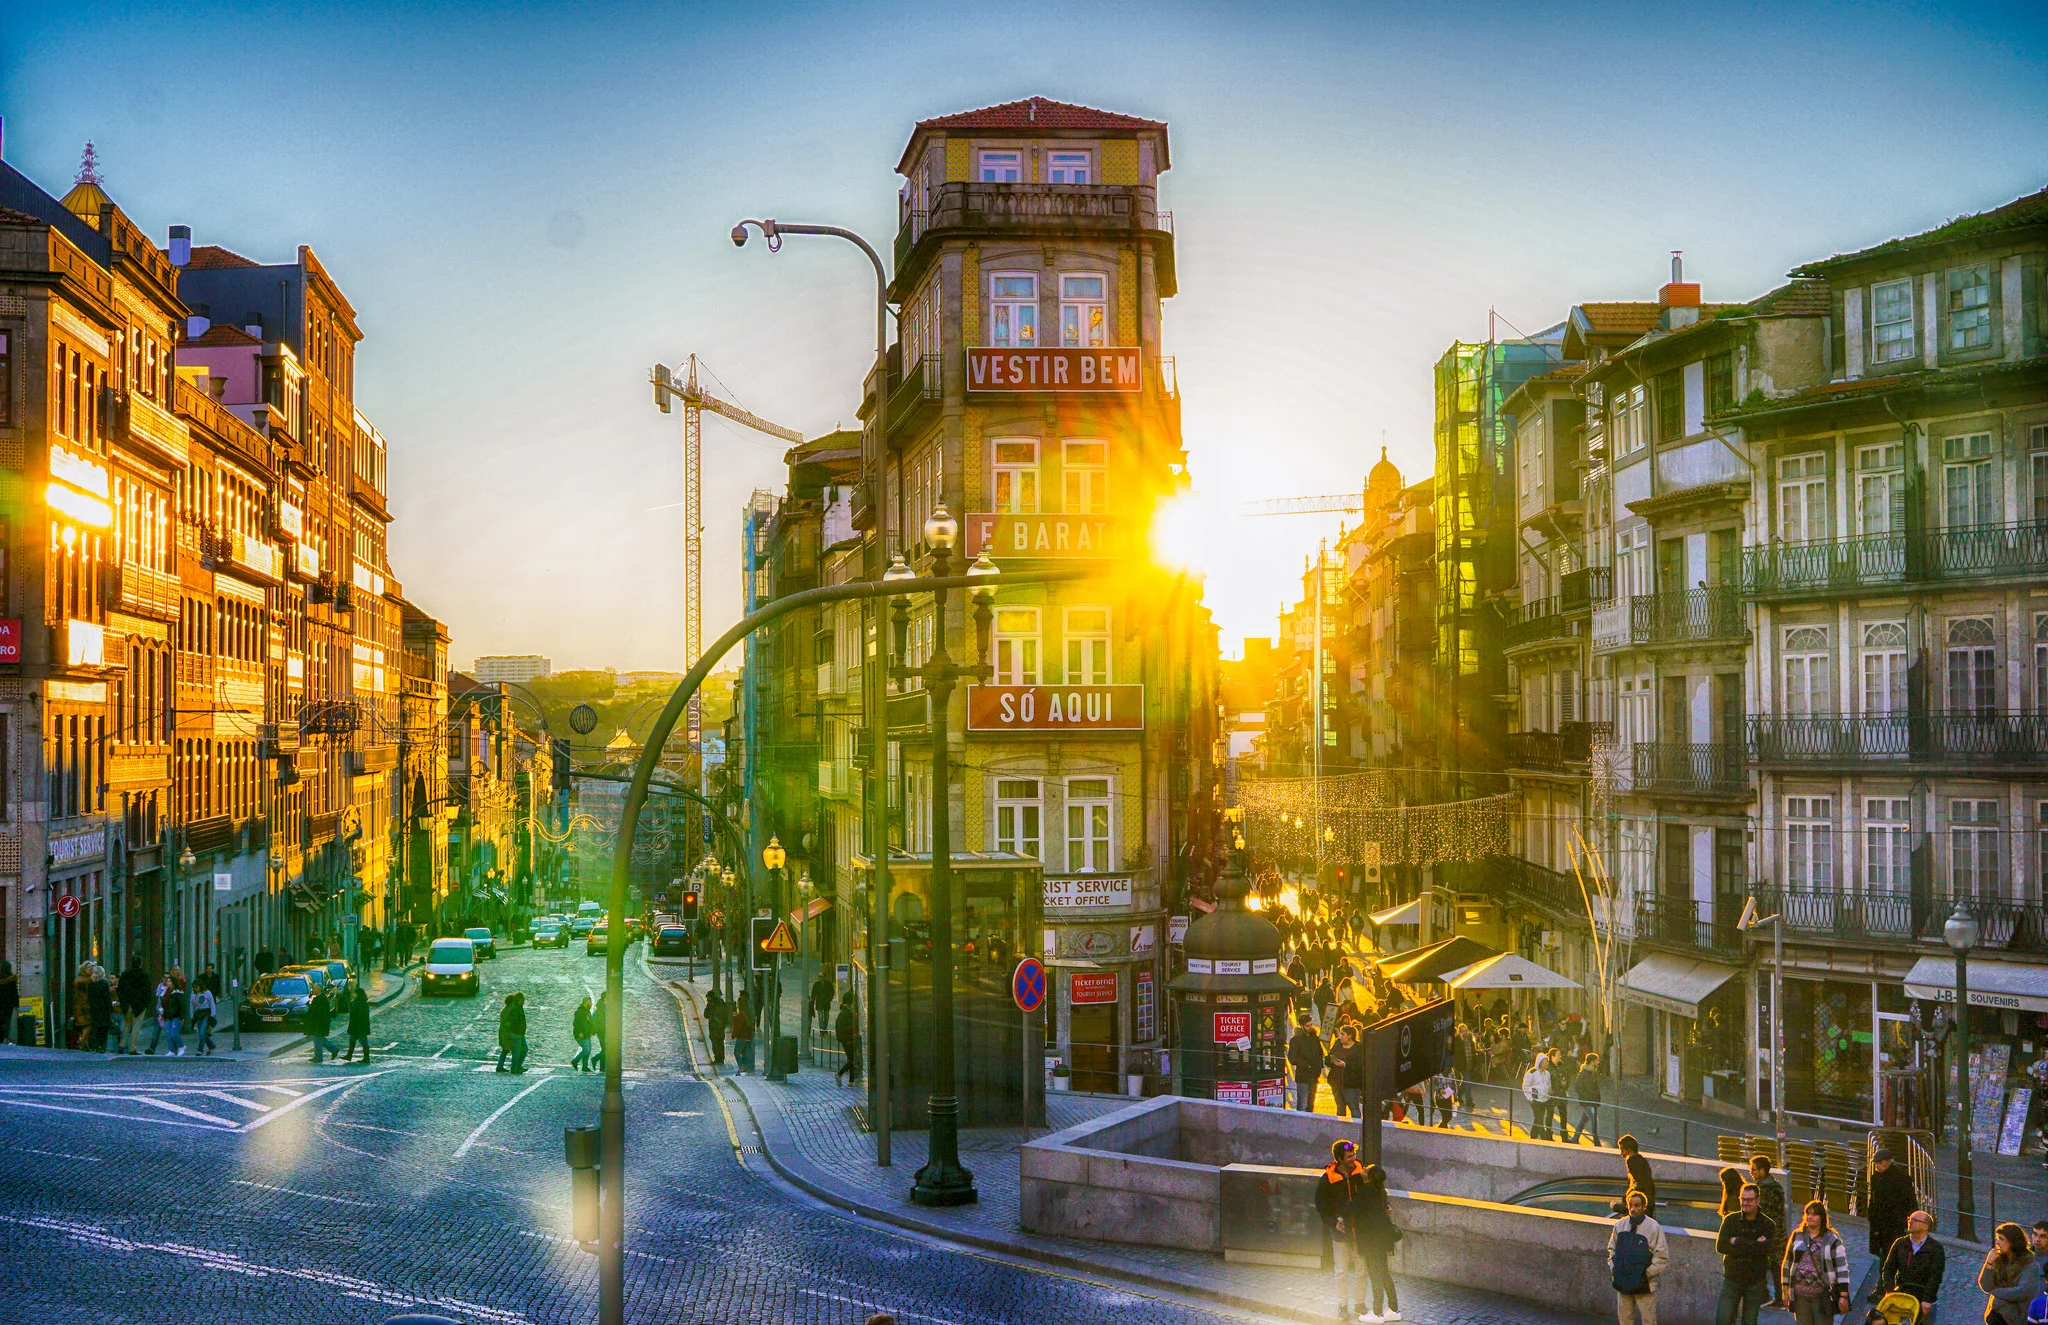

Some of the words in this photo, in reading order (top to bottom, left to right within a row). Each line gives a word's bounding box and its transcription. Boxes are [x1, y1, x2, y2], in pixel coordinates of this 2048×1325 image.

[971, 356, 1069, 384] VESTIR
[1081, 356, 1136, 384] BEM
[981, 522, 994, 550] E
[1000, 688, 1035, 722] SÓ
[1048, 692, 1112, 722] AQUI
[49, 838, 78, 860] TOURIST
[80, 832, 105, 856] SERVICE
[1077, 880, 1128, 893] SERVICE
[1075, 895, 1110, 905] OFFICE
[1074, 979, 1095, 987] TICKET
[1970, 993, 2020, 1007] SOUVENIRS
